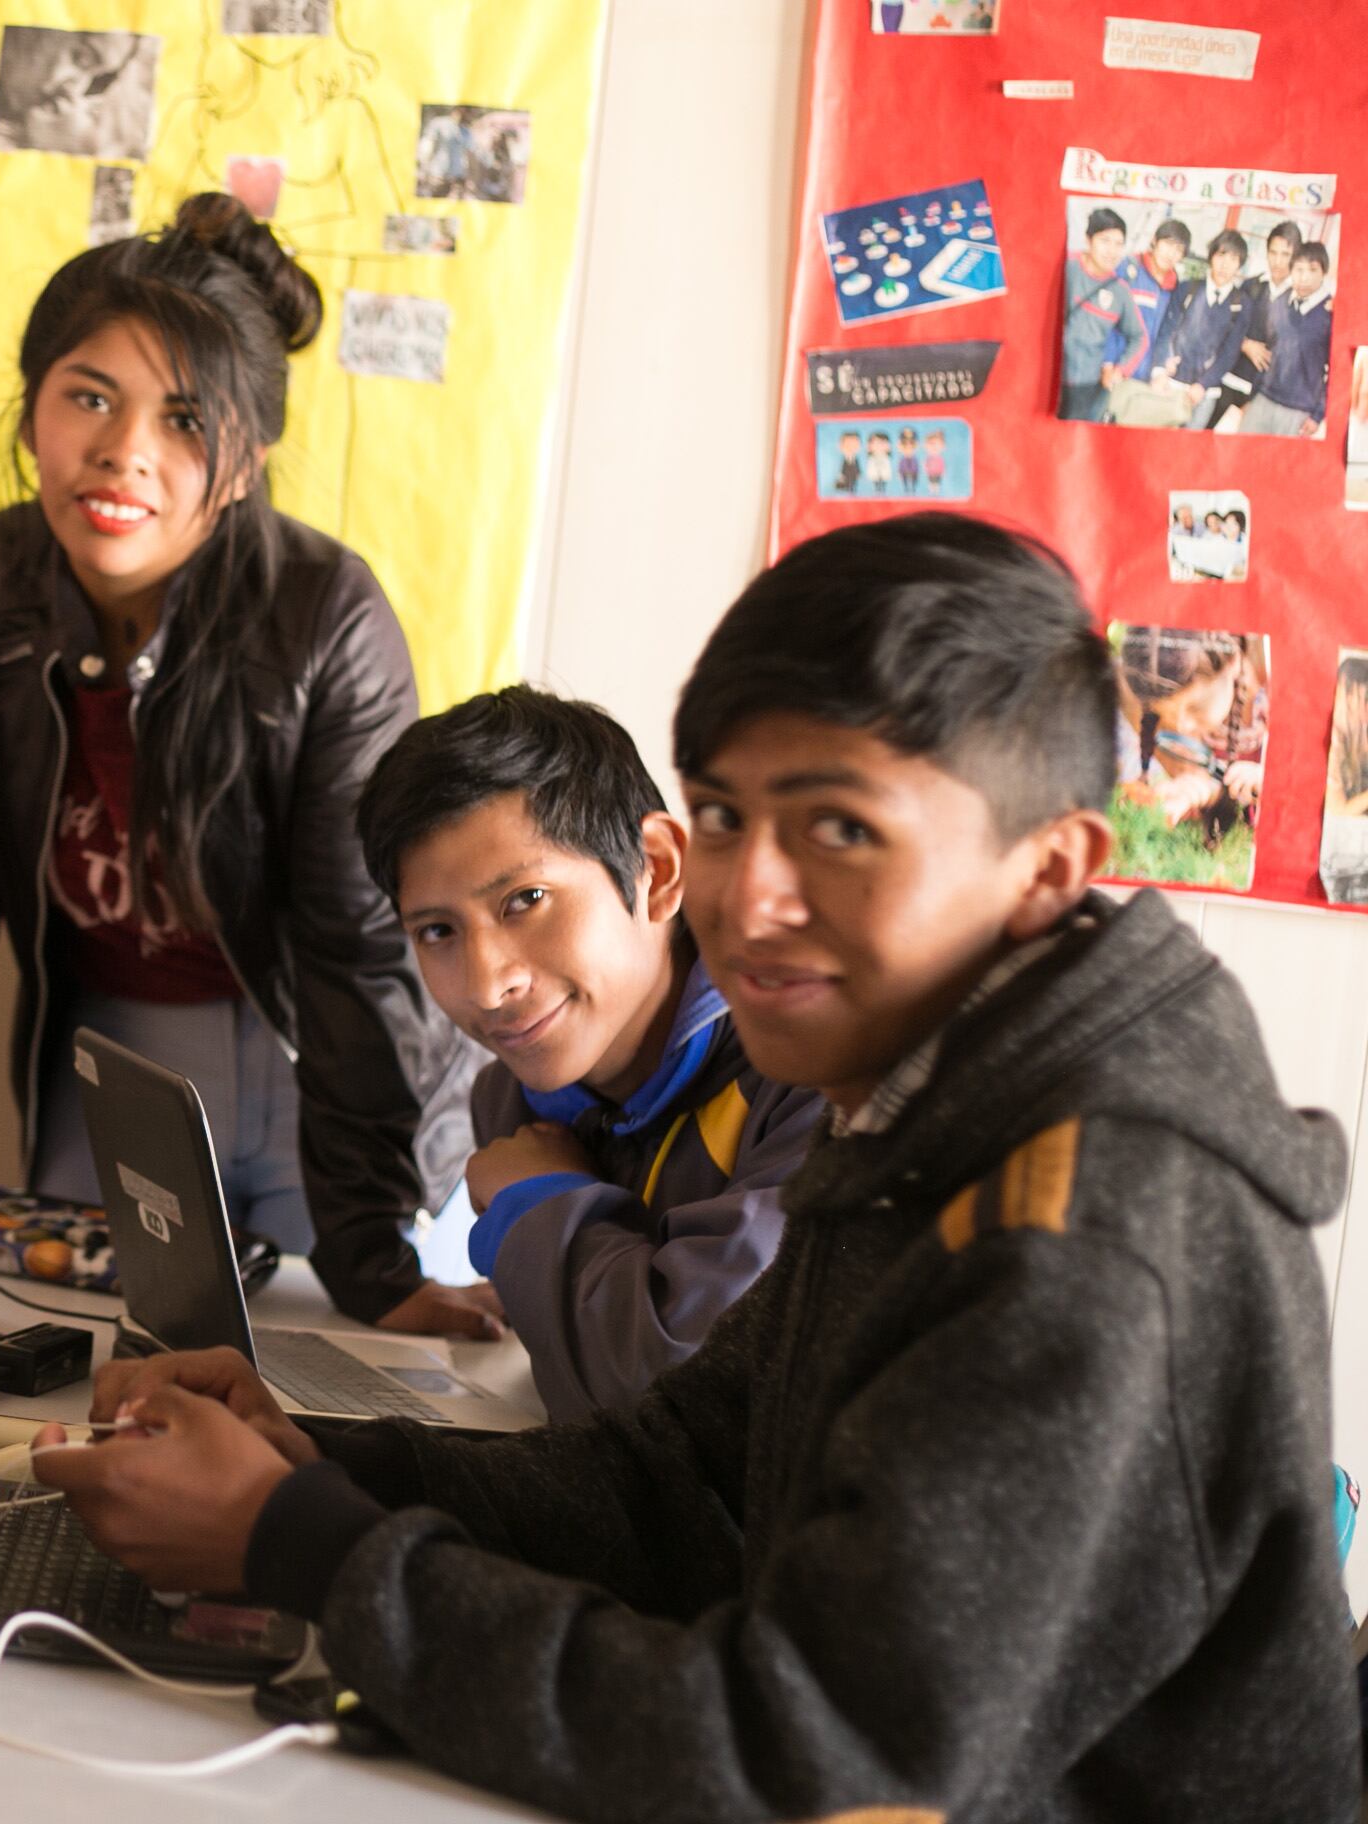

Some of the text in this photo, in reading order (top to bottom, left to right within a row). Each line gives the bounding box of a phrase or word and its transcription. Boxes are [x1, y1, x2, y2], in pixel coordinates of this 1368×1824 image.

[1076, 150, 1188, 195] Regreso
[1200, 181, 1214, 199] a
[851, 380, 975, 406] CAPACITADO
